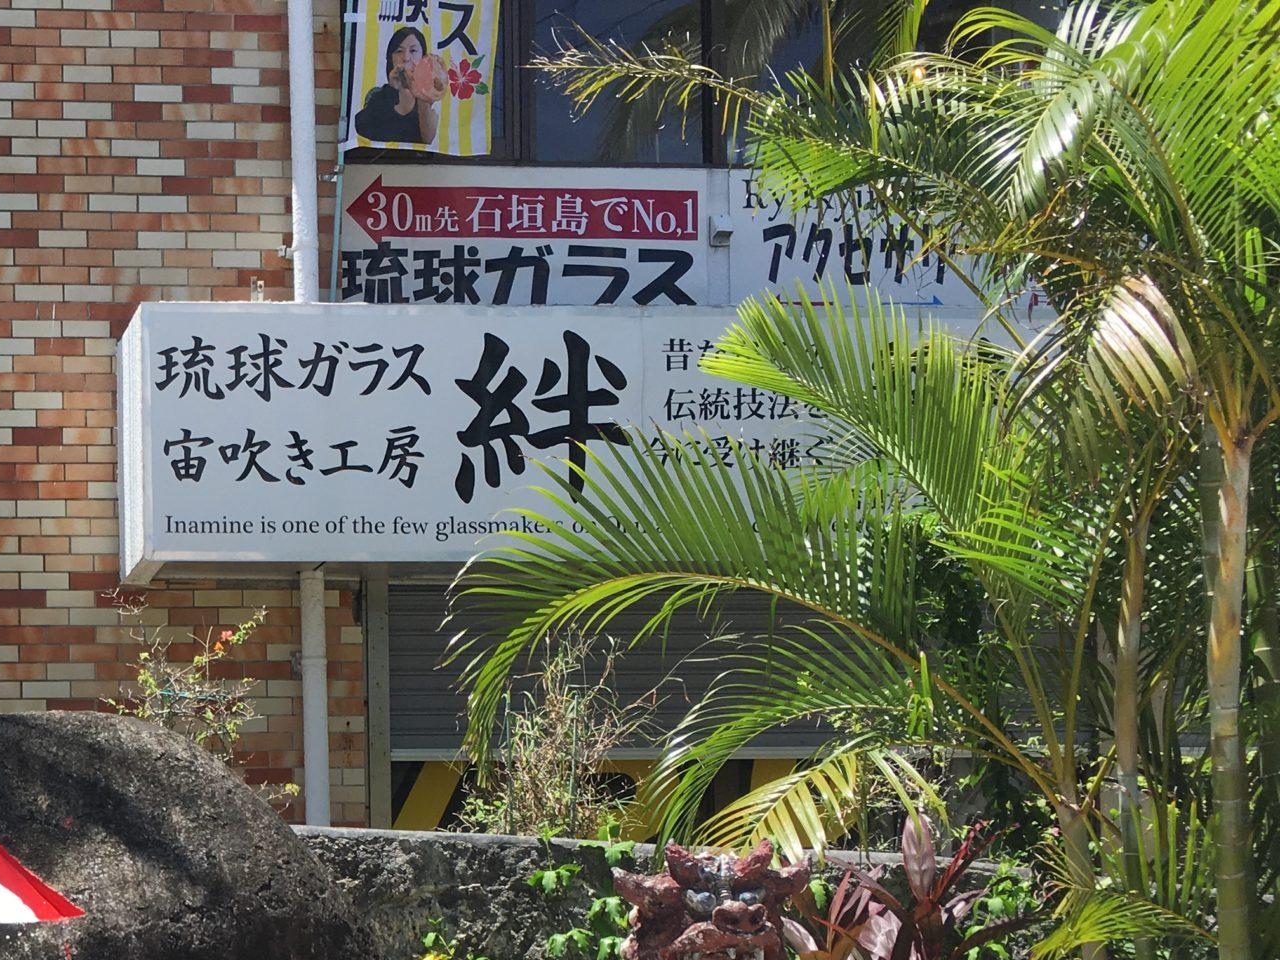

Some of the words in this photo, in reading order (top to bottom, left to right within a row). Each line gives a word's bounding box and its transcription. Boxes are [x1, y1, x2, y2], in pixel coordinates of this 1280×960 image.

[341, 241, 698, 305] 琉球ガラス
[762, 222, 960, 286] アクセサリ
[154, 332, 432, 402] 琉球ガラス
[454, 330, 634, 504] 絆
[163, 426, 425, 489] 宙吹き工房
[164, 515, 254, 534] Inamine
[260, 515, 276, 534] is
[282, 519, 321, 534] one
[325, 515, 349, 534] of
[352, 515, 386, 534] the
[392, 515, 429, 534] few
